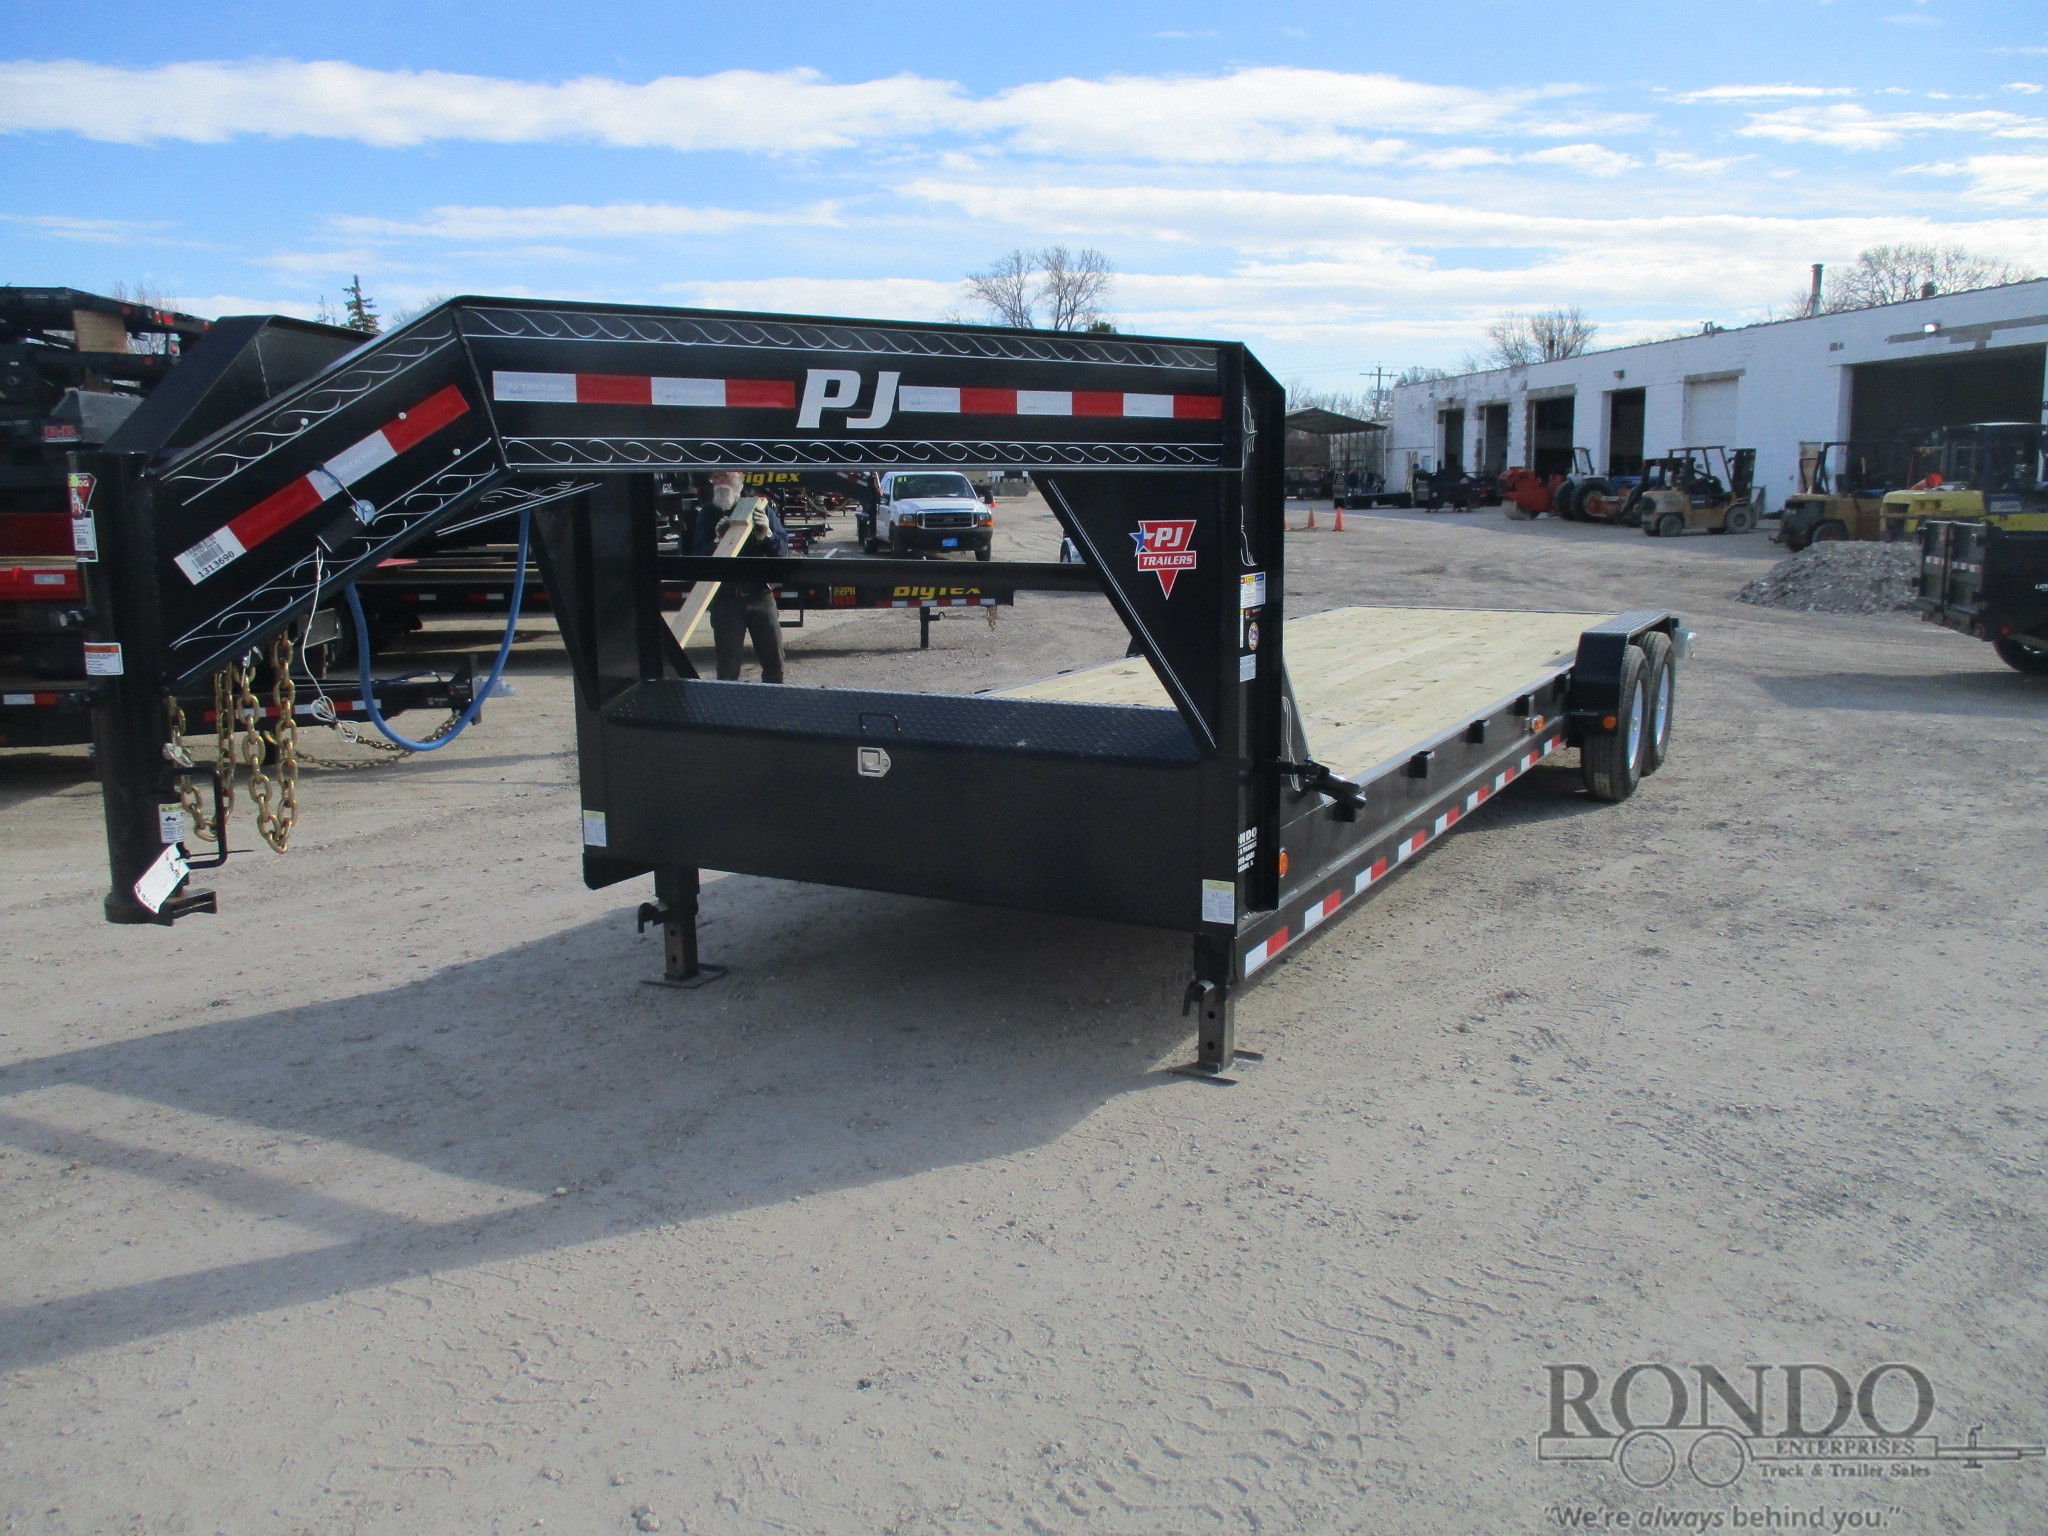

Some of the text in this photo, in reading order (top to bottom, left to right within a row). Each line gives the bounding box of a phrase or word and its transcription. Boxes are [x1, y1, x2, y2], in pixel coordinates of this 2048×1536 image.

[796, 369, 901, 429] PJ
[1154, 527, 1184, 548] PJ
[198, 550, 235, 578] 1313690
[1143, 555, 1194, 566] TRAILERS
